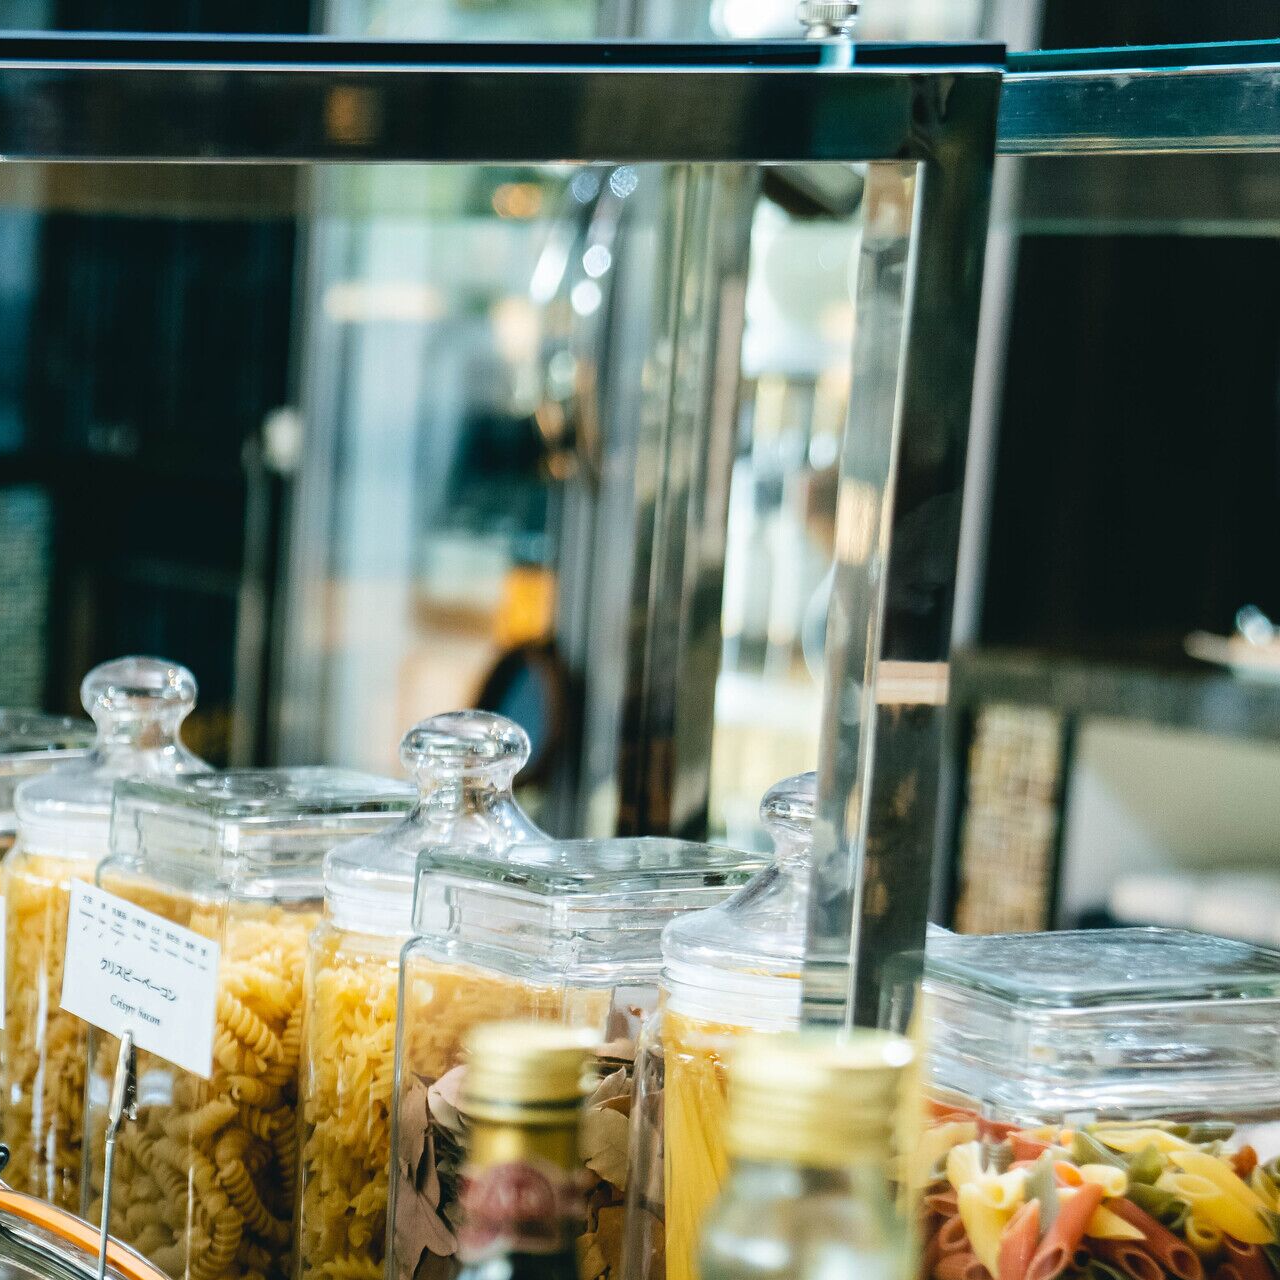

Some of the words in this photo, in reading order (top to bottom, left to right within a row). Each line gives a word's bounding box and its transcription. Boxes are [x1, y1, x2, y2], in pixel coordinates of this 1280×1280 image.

[99, 957, 178, 1002] クリスピーベーコン
[109, 993, 137, 1016] Crispy
[137, 1006, 162, 1027] bacon
